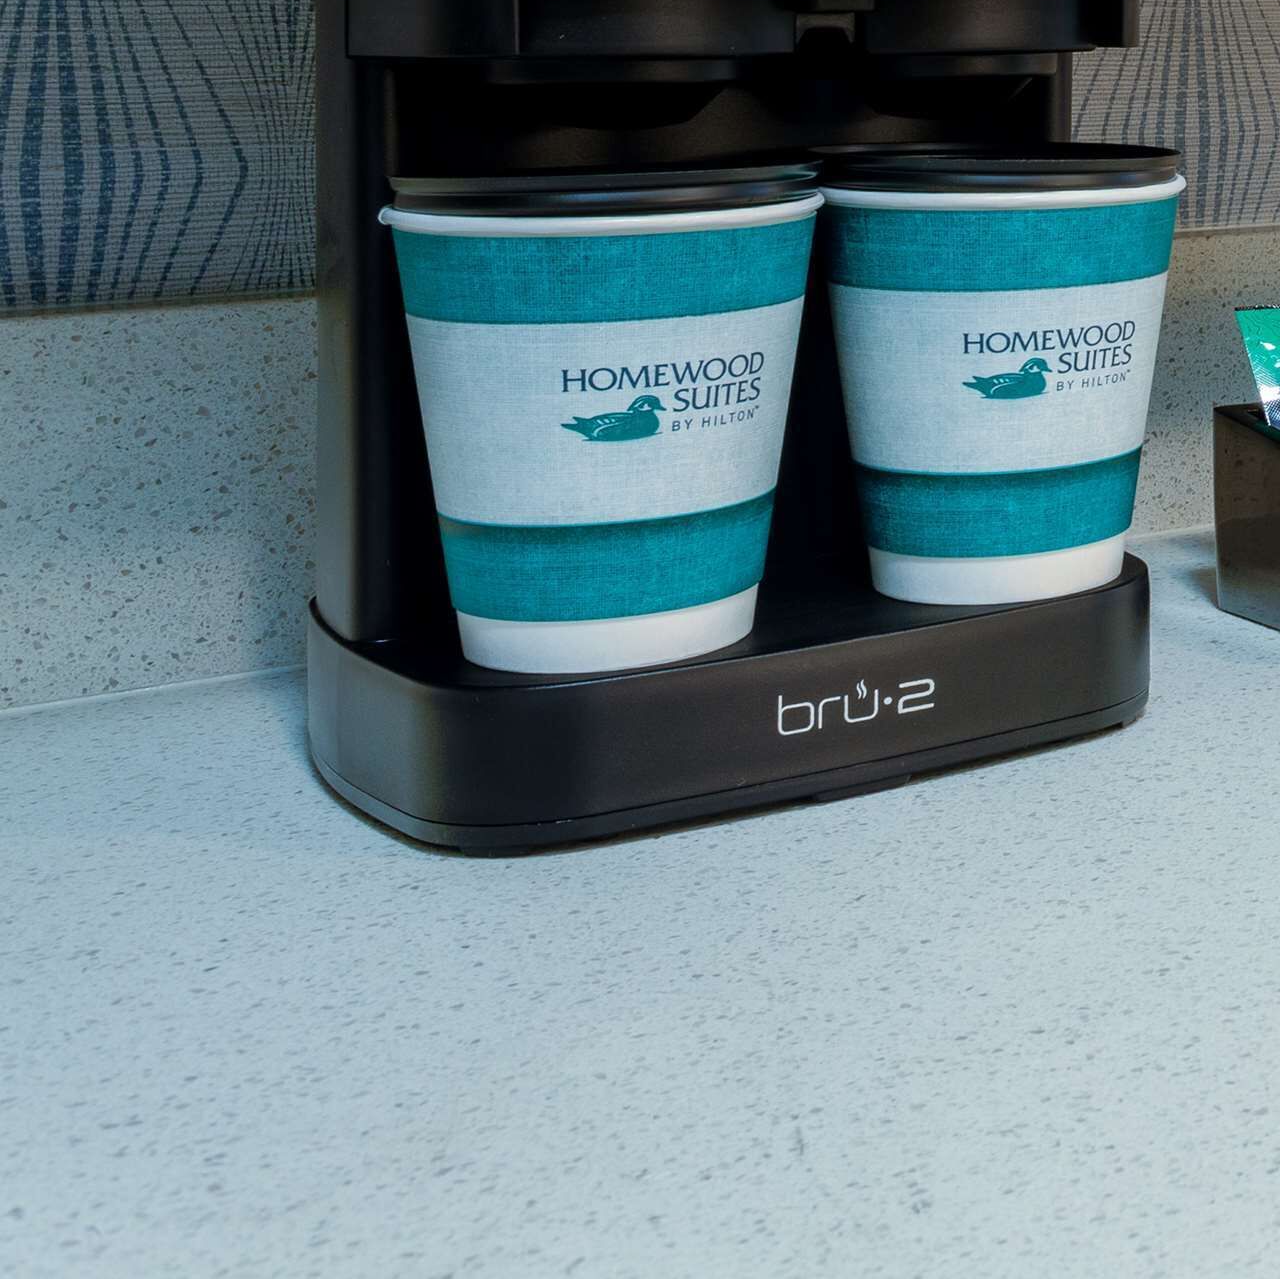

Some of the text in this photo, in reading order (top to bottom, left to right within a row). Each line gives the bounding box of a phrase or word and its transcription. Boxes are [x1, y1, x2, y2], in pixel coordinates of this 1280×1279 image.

[961, 320, 1136, 354] HOMEWOOD
[561, 351, 765, 393] HOMEWOOD
[1057, 343, 1132, 374] SUITES
[672, 377, 761, 412] SUITES
[1056, 372, 1127, 392] BY HILTON
[671, 409, 755, 432] BY HILTON
